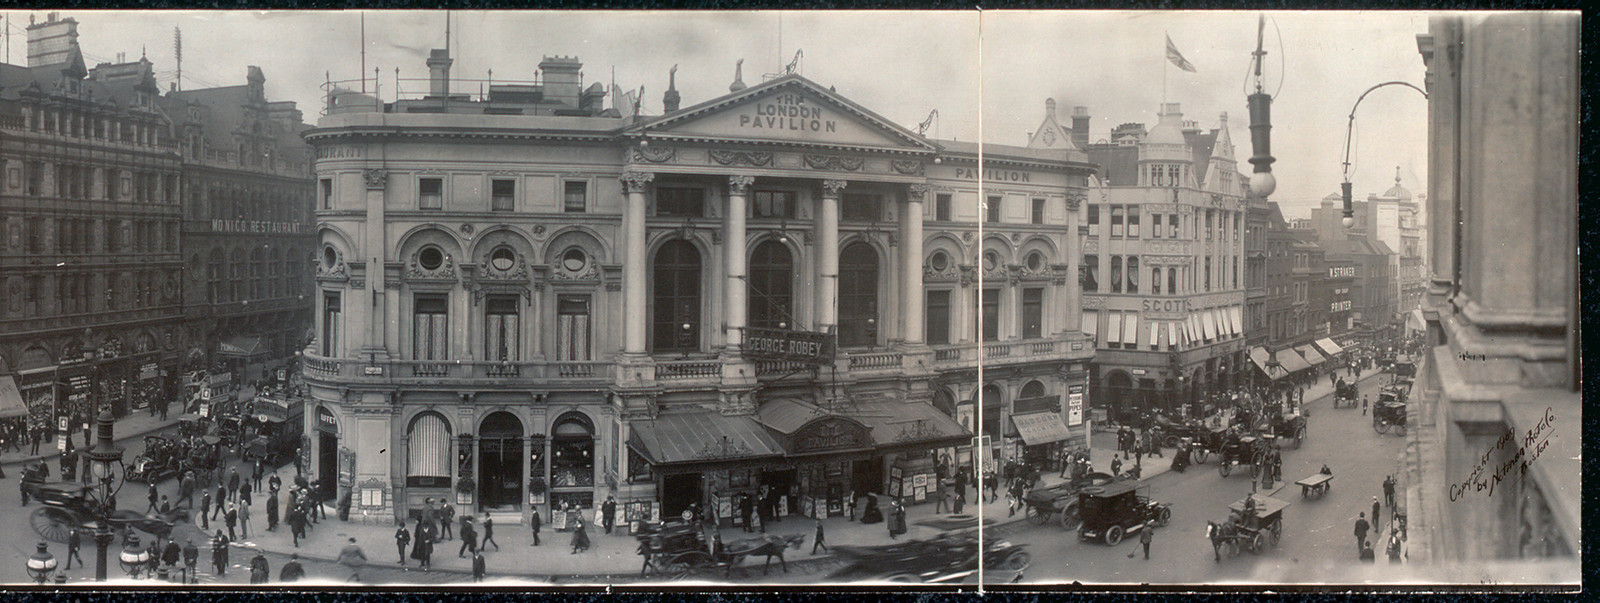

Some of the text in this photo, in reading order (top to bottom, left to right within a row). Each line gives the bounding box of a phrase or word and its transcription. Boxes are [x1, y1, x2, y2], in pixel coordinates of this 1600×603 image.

[776, 94, 804, 105] THE
[757, 103, 821, 119] LONDON
[740, 115, 835, 133] PAVILION
[212, 219, 300, 233] MONICO RESTAURANT
[1331, 300, 1352, 313] PRINTER
[748, 337, 822, 357] GEORGE ROBEY
